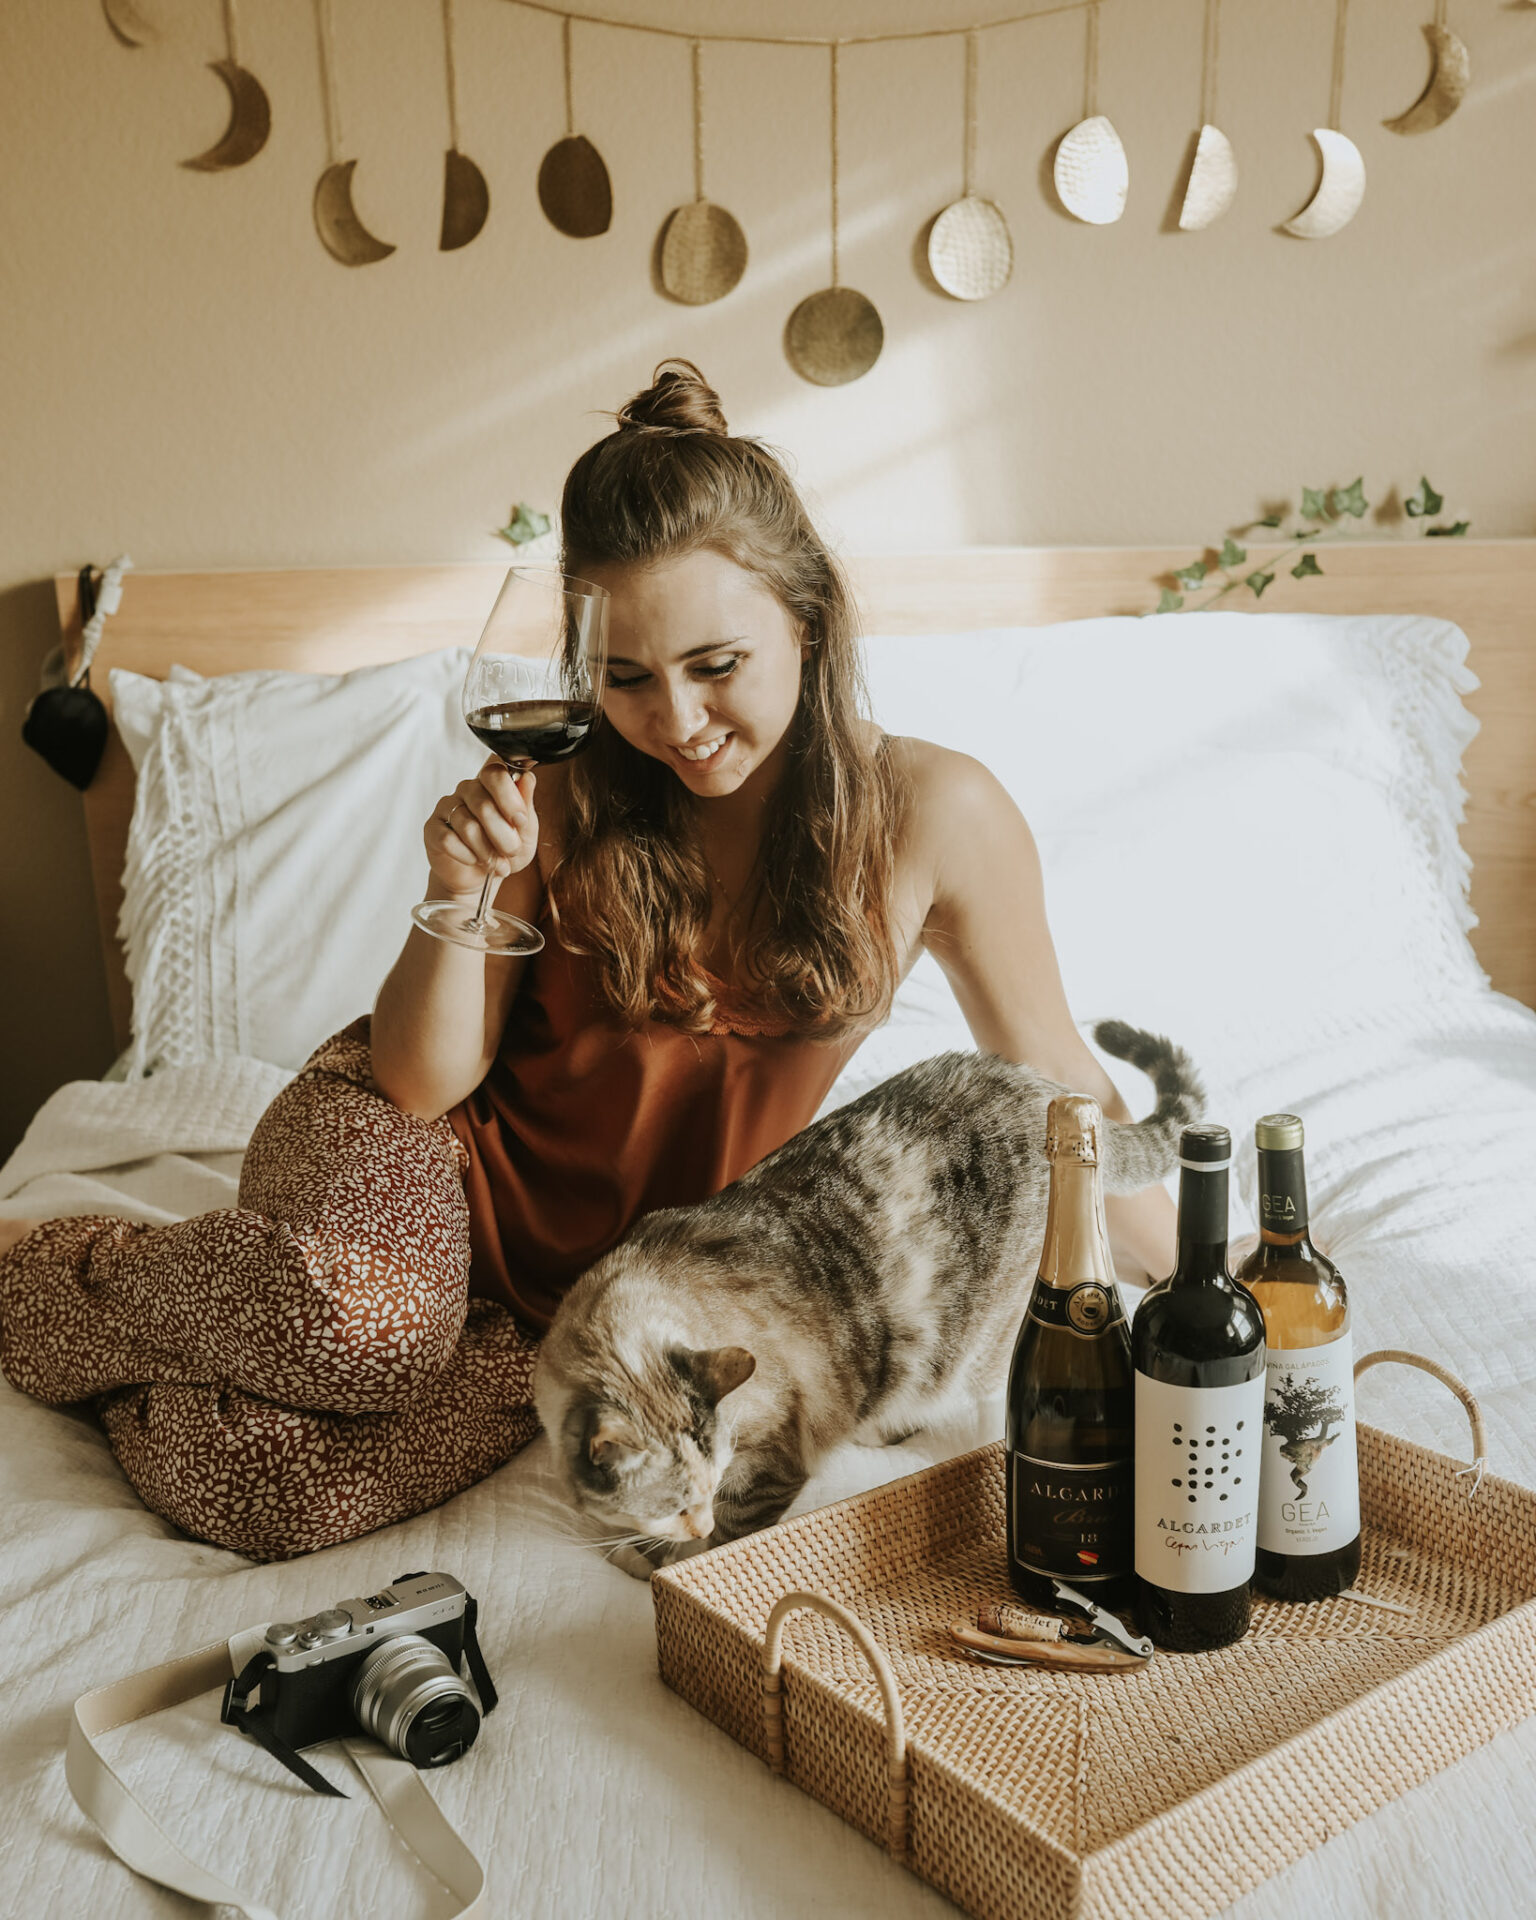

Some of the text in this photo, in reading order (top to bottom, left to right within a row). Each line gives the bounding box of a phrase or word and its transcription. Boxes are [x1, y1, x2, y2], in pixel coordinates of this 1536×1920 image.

[1262, 1193, 1296, 1212] GEA
[1029, 1482, 1119, 1502] ALGARD
[1281, 1501, 1330, 1522] GEA
[1157, 1512, 1251, 1534] ALGARDET
